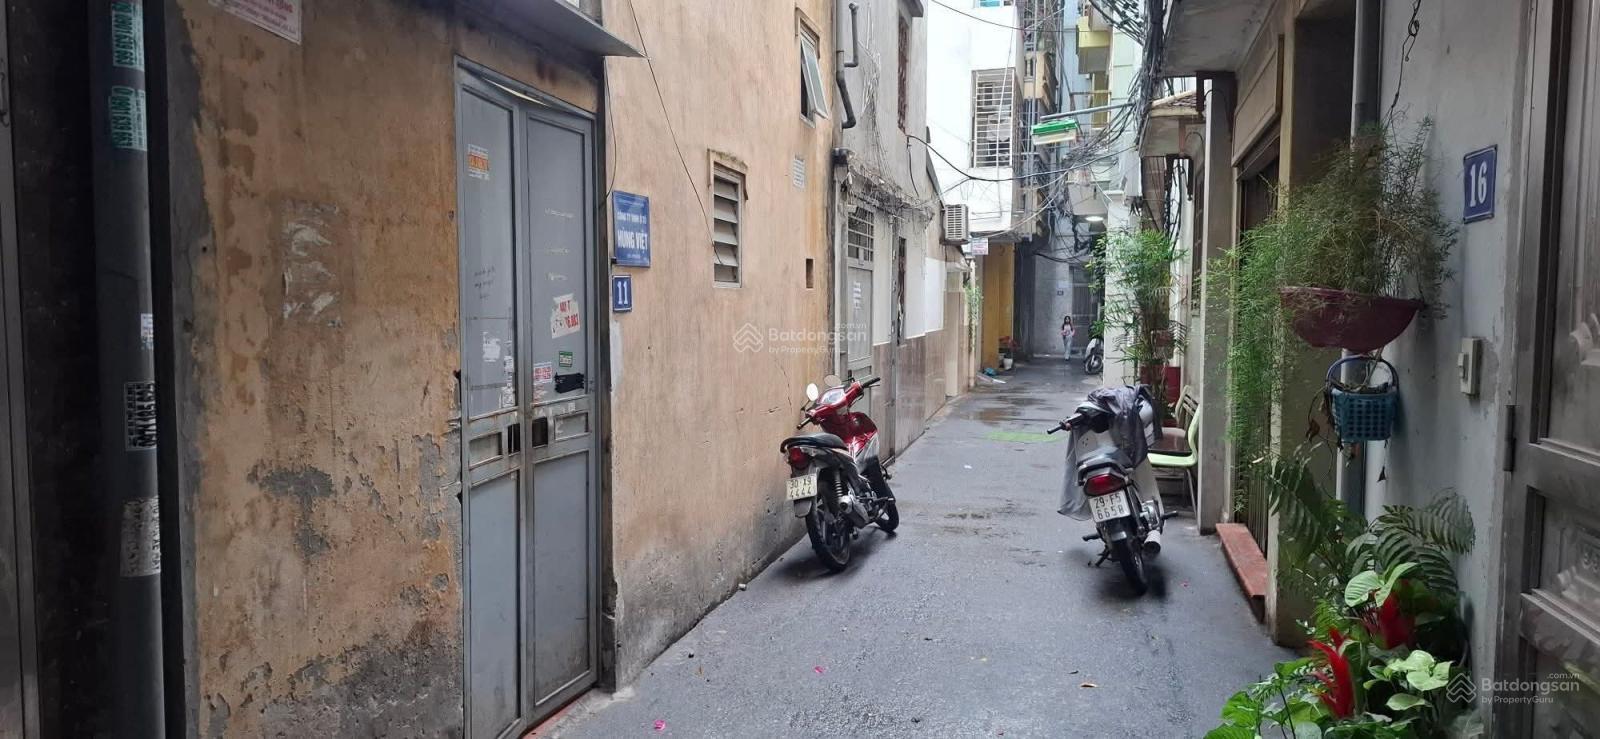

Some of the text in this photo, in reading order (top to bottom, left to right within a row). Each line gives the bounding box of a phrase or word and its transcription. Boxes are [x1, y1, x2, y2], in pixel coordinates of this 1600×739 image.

[1469, 160, 1488, 208] 16
[617, 226, 648, 254] HÙNG VIỆT
[617, 280, 628, 305] 11
[1096, 504, 1124, 520] 6658
